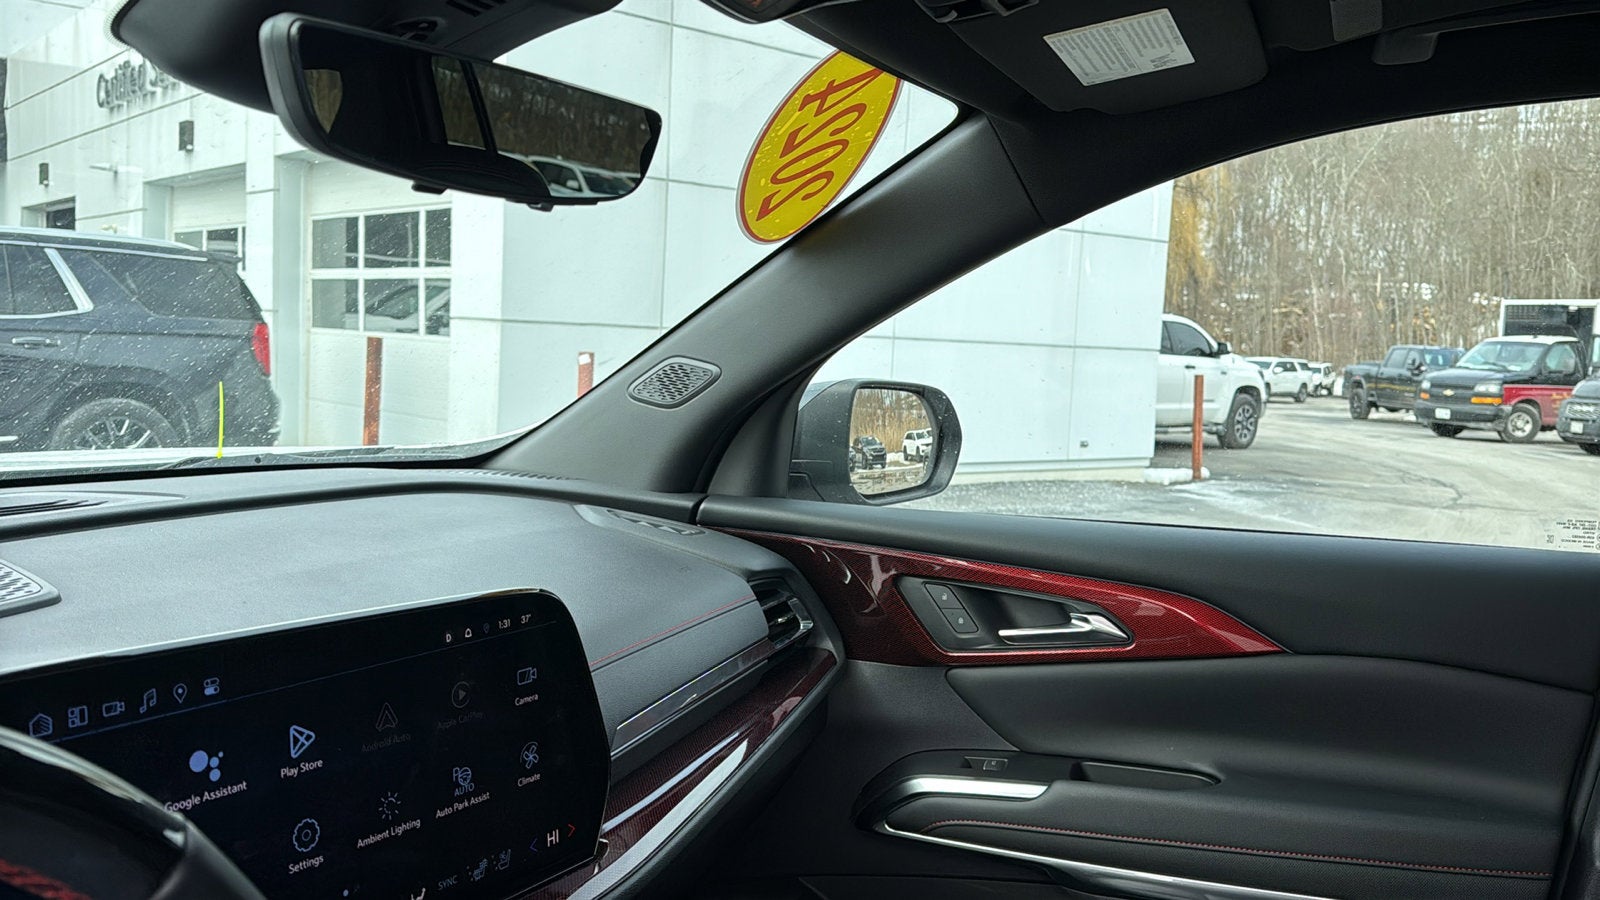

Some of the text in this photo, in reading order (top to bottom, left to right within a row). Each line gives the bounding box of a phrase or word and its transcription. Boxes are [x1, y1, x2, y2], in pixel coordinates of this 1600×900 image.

[498, 618, 511, 630] 1:31
[514, 692, 539, 706] Camera
[280, 758, 324, 779] Play Store
[517, 771, 541, 787] Climate
[164, 780, 248, 813] Google Assistant
[454, 782, 475, 798] AUTO
[435, 791, 490, 819] Auto Park Assist
[356, 817, 421, 849] Ambient Lighting
[546, 830, 560, 846] HI
[288, 854, 325, 875] Settings
[438, 874, 459, 891] SYNC
